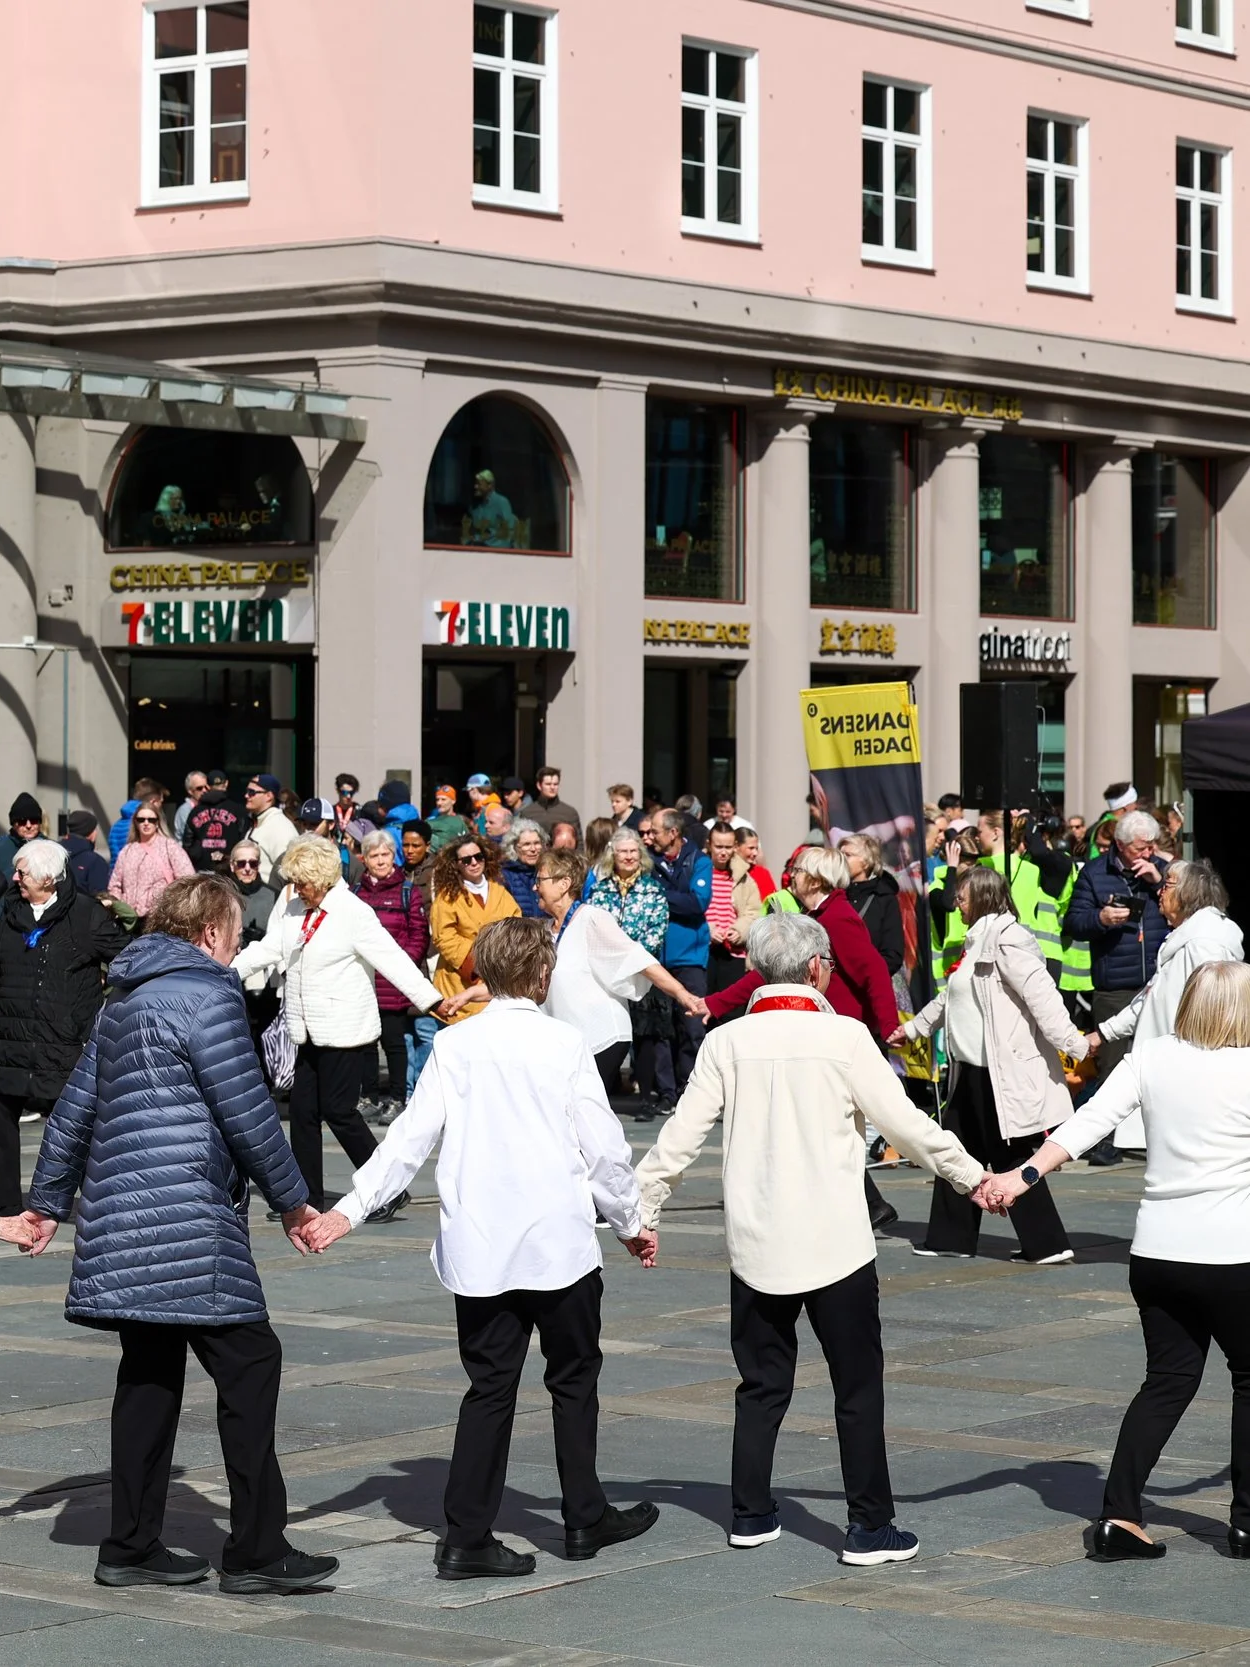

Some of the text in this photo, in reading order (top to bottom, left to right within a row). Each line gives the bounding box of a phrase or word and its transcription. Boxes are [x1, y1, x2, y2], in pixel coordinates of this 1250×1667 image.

[814, 371, 891, 406] CHINA
[896, 381, 990, 419] PALACE
[207, 510, 272, 527] PALACE
[110, 559, 311, 588] CHINA PALACE
[674, 620, 751, 644] PALACE
